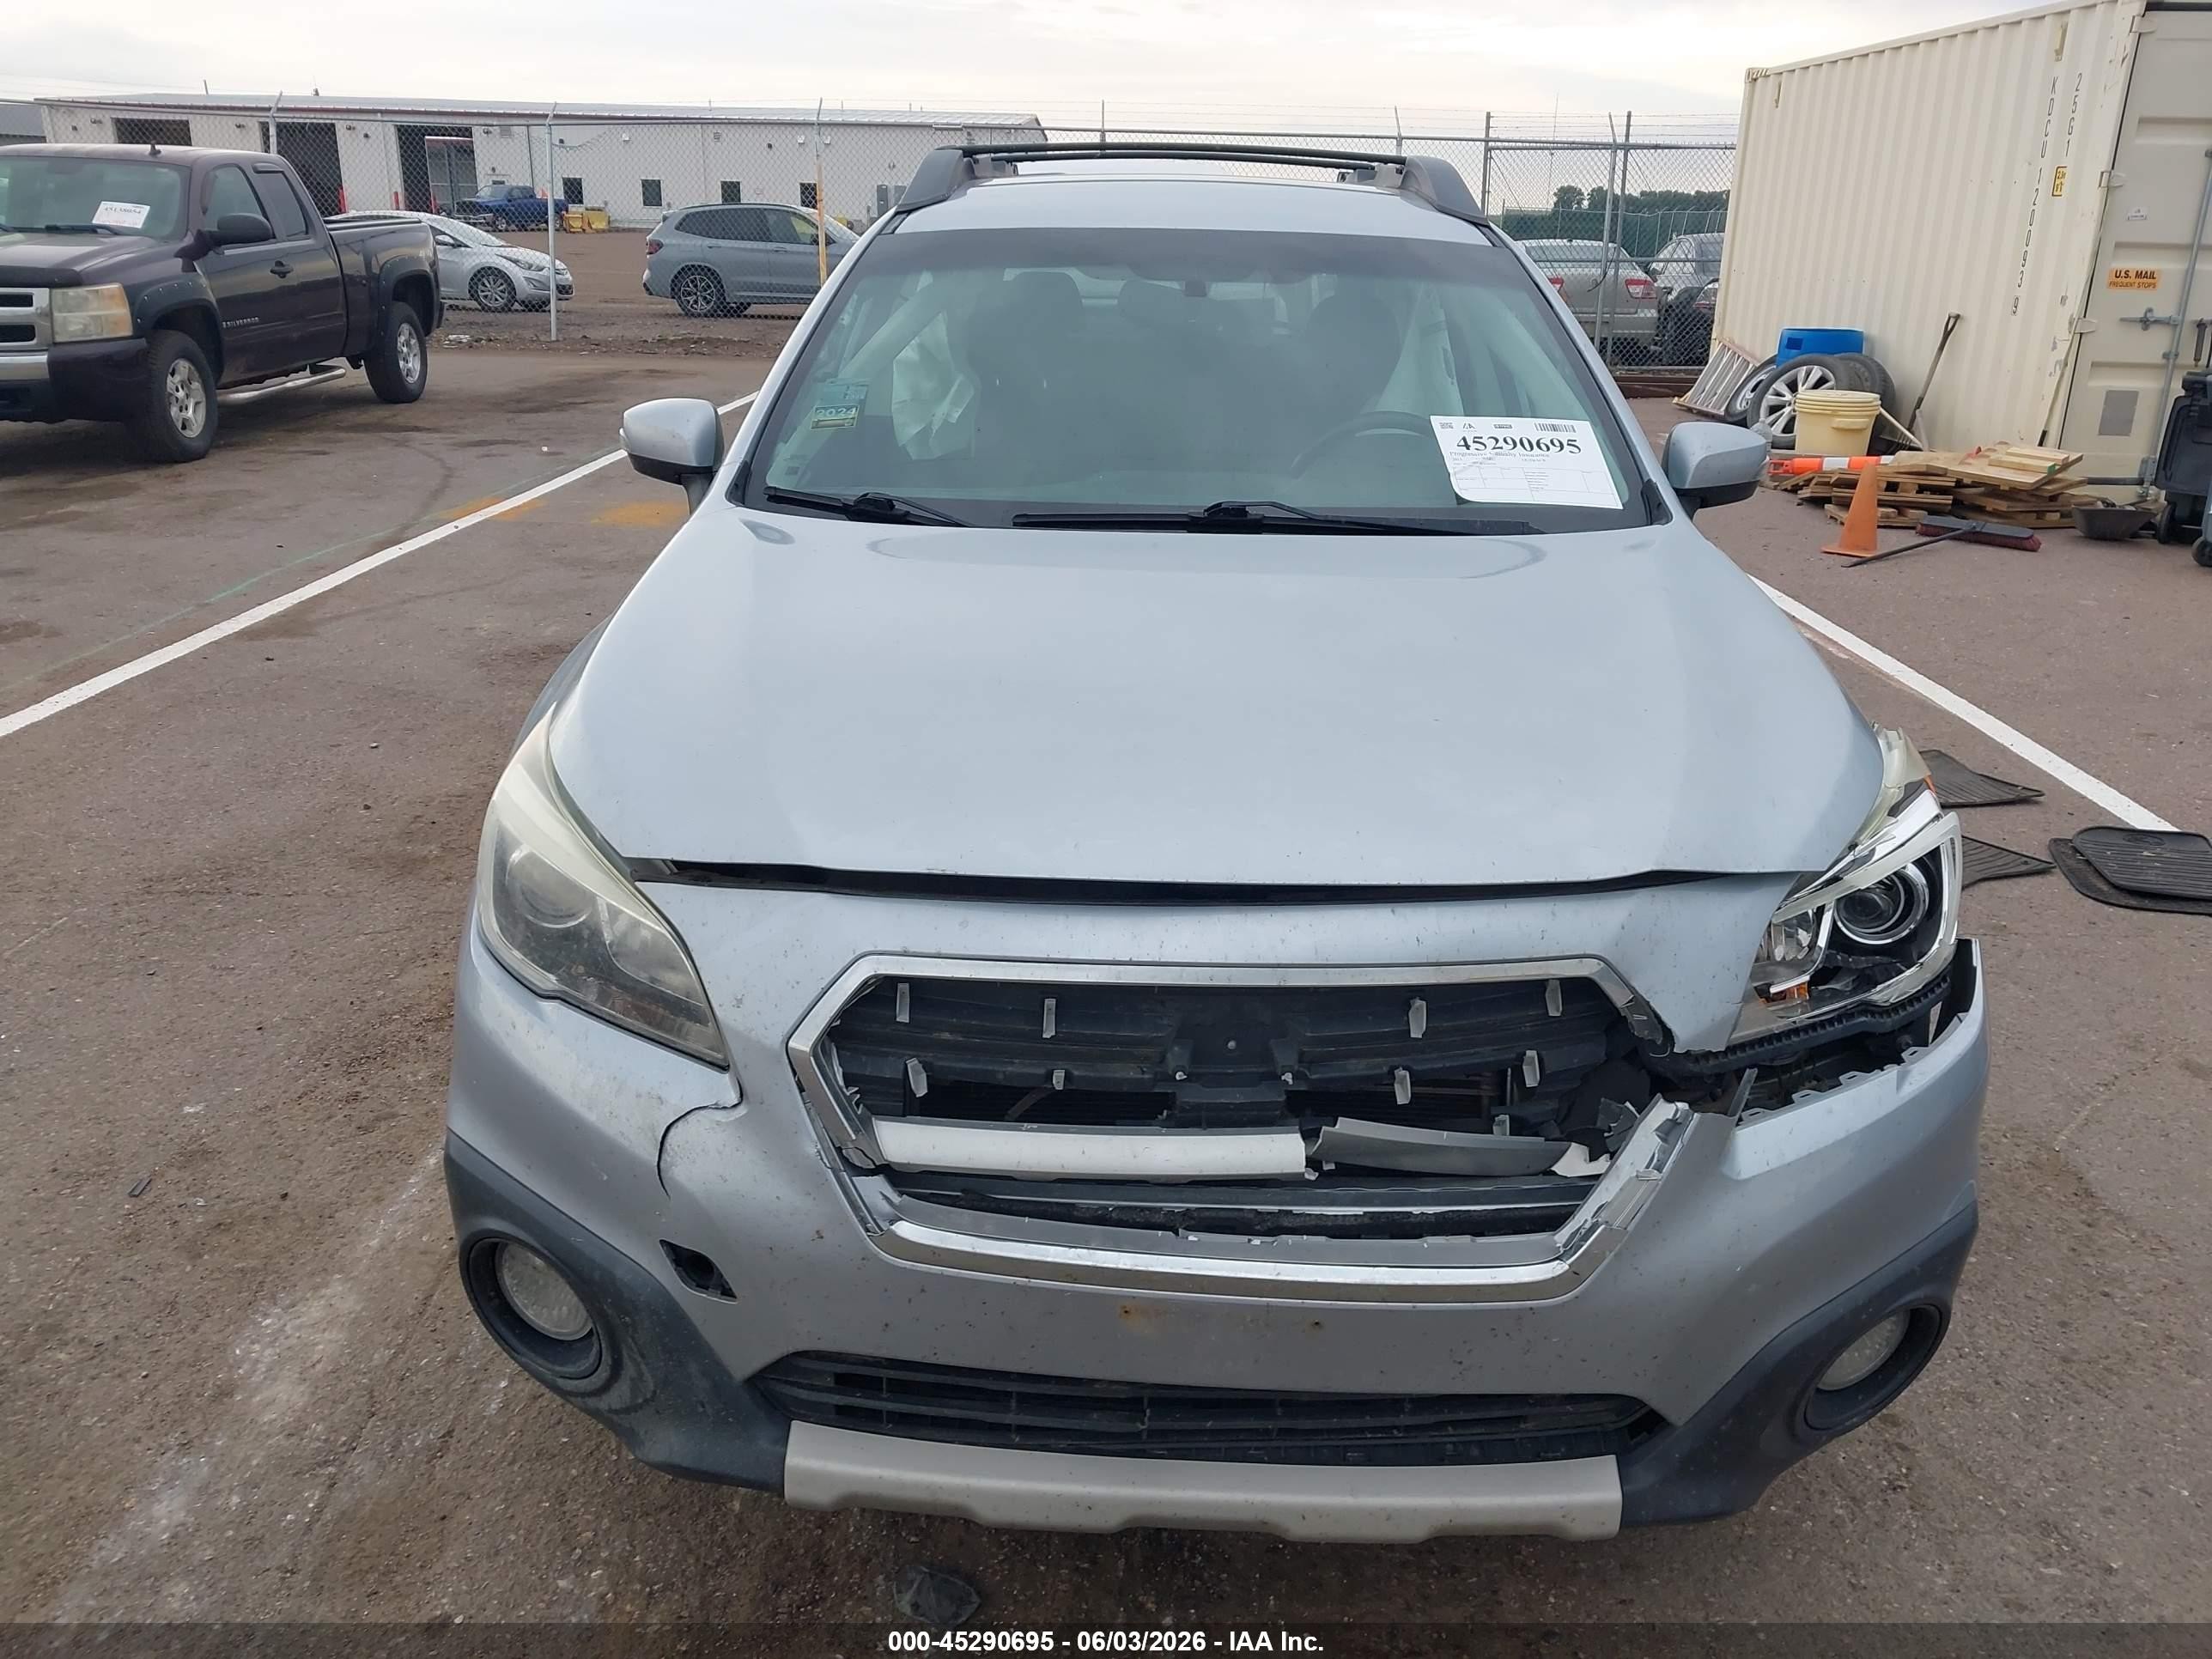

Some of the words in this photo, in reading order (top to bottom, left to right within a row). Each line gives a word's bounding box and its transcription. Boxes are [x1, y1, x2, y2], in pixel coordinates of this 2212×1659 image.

[2040, 76, 2058, 158] KOCU
[2065, 72, 2082, 157] 25G1
[2018, 167, 2042, 289] 120093
[2114, 269, 2132, 279] U.S.
[2135, 269, 2157, 280] MAIL
[2137, 281, 2158, 289] STOPS
[817, 407, 857, 417] 2024
[1456, 434, 1582, 455] 45290695
